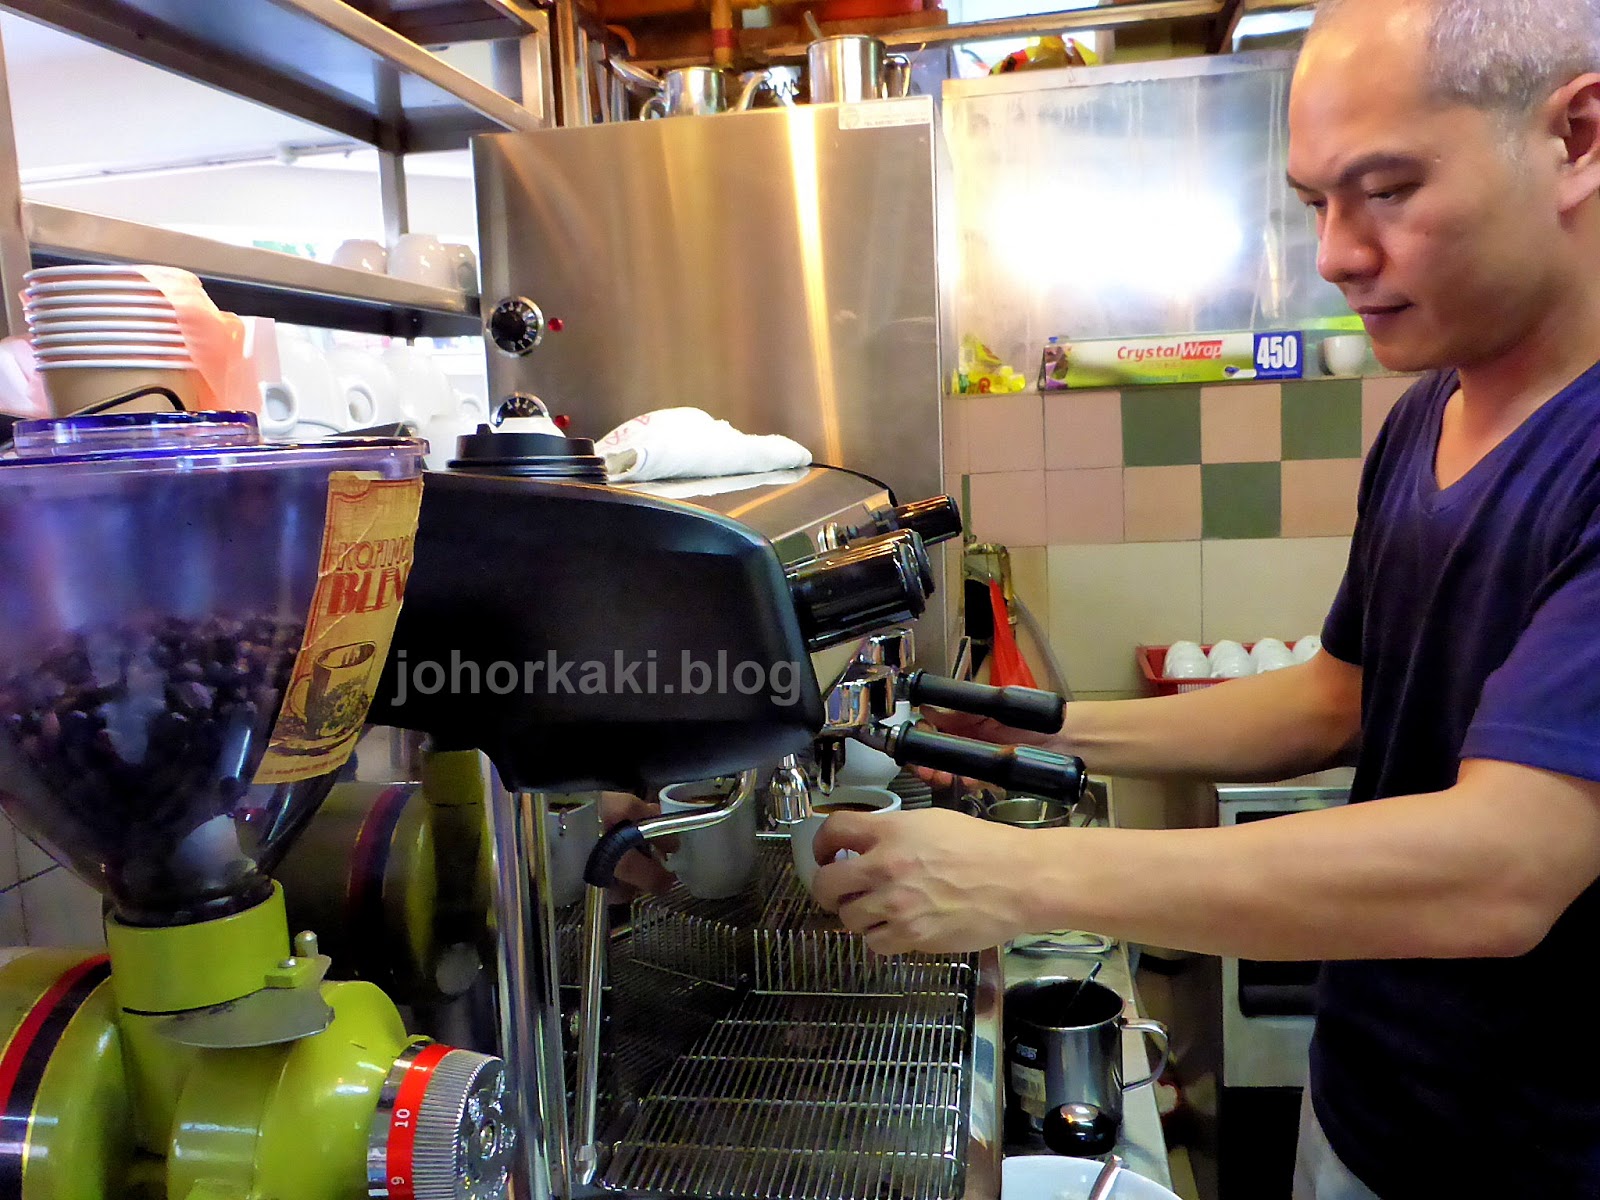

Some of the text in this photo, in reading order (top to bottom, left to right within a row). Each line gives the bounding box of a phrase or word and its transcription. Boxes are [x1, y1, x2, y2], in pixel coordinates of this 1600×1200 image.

[1117, 335, 1298, 369] CrystalWrap 450
[394, 1108, 411, 1128] 10
